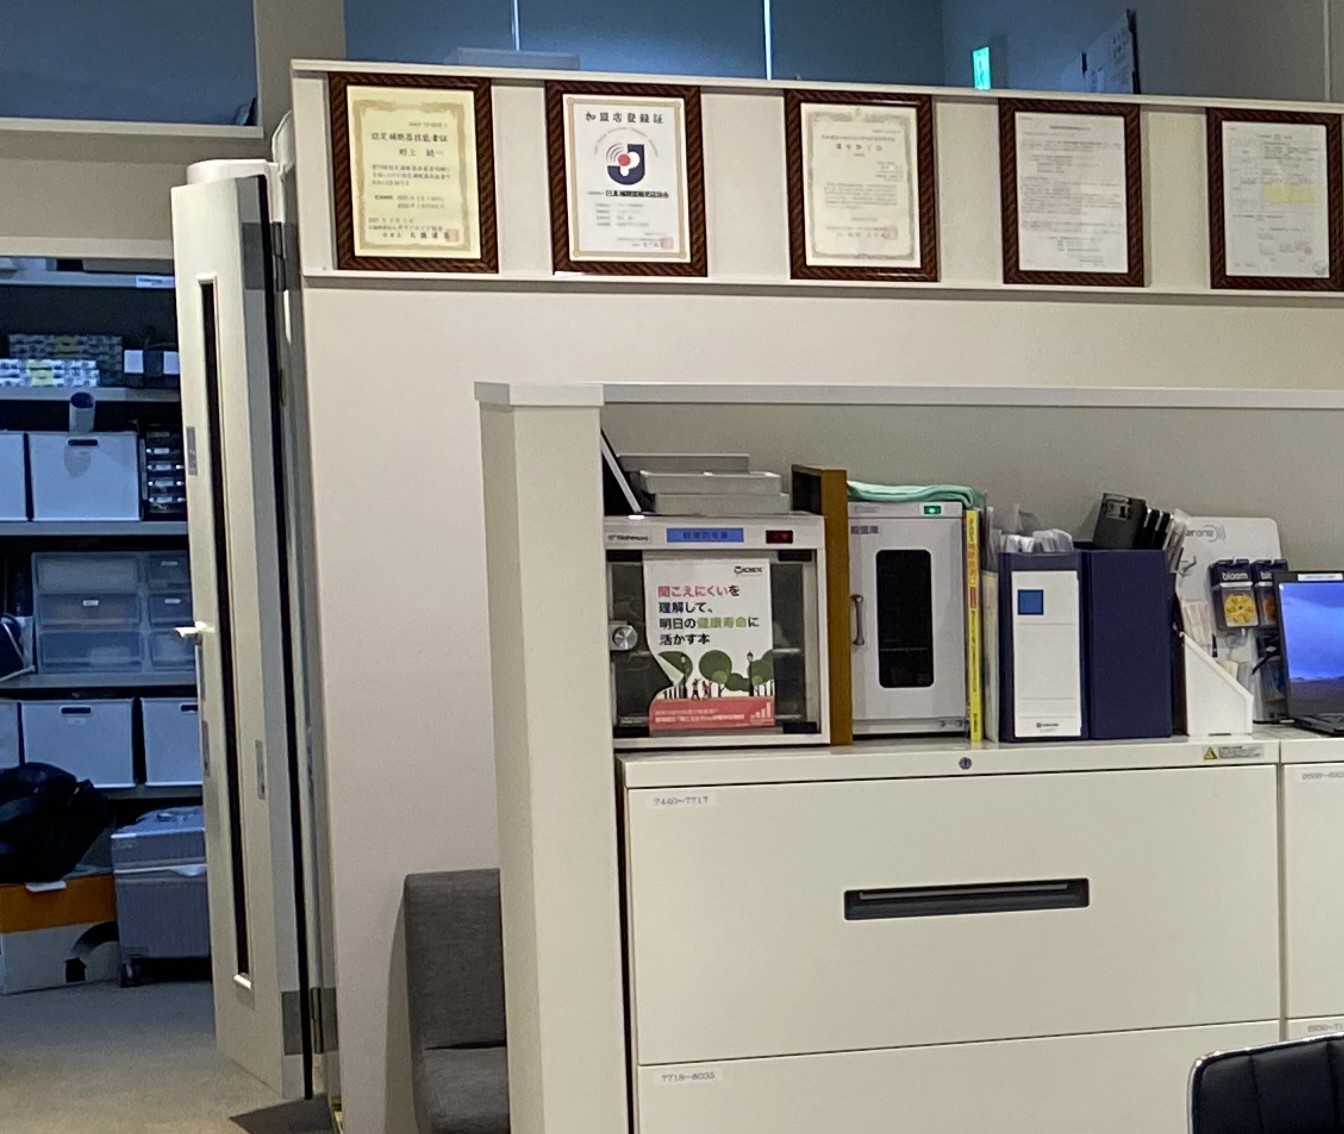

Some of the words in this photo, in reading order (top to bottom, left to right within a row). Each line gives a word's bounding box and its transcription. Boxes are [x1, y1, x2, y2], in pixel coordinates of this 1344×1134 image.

[1221, 571, 1249, 581] bloom
[657, 584, 741, 598] 聞こえにくいを
